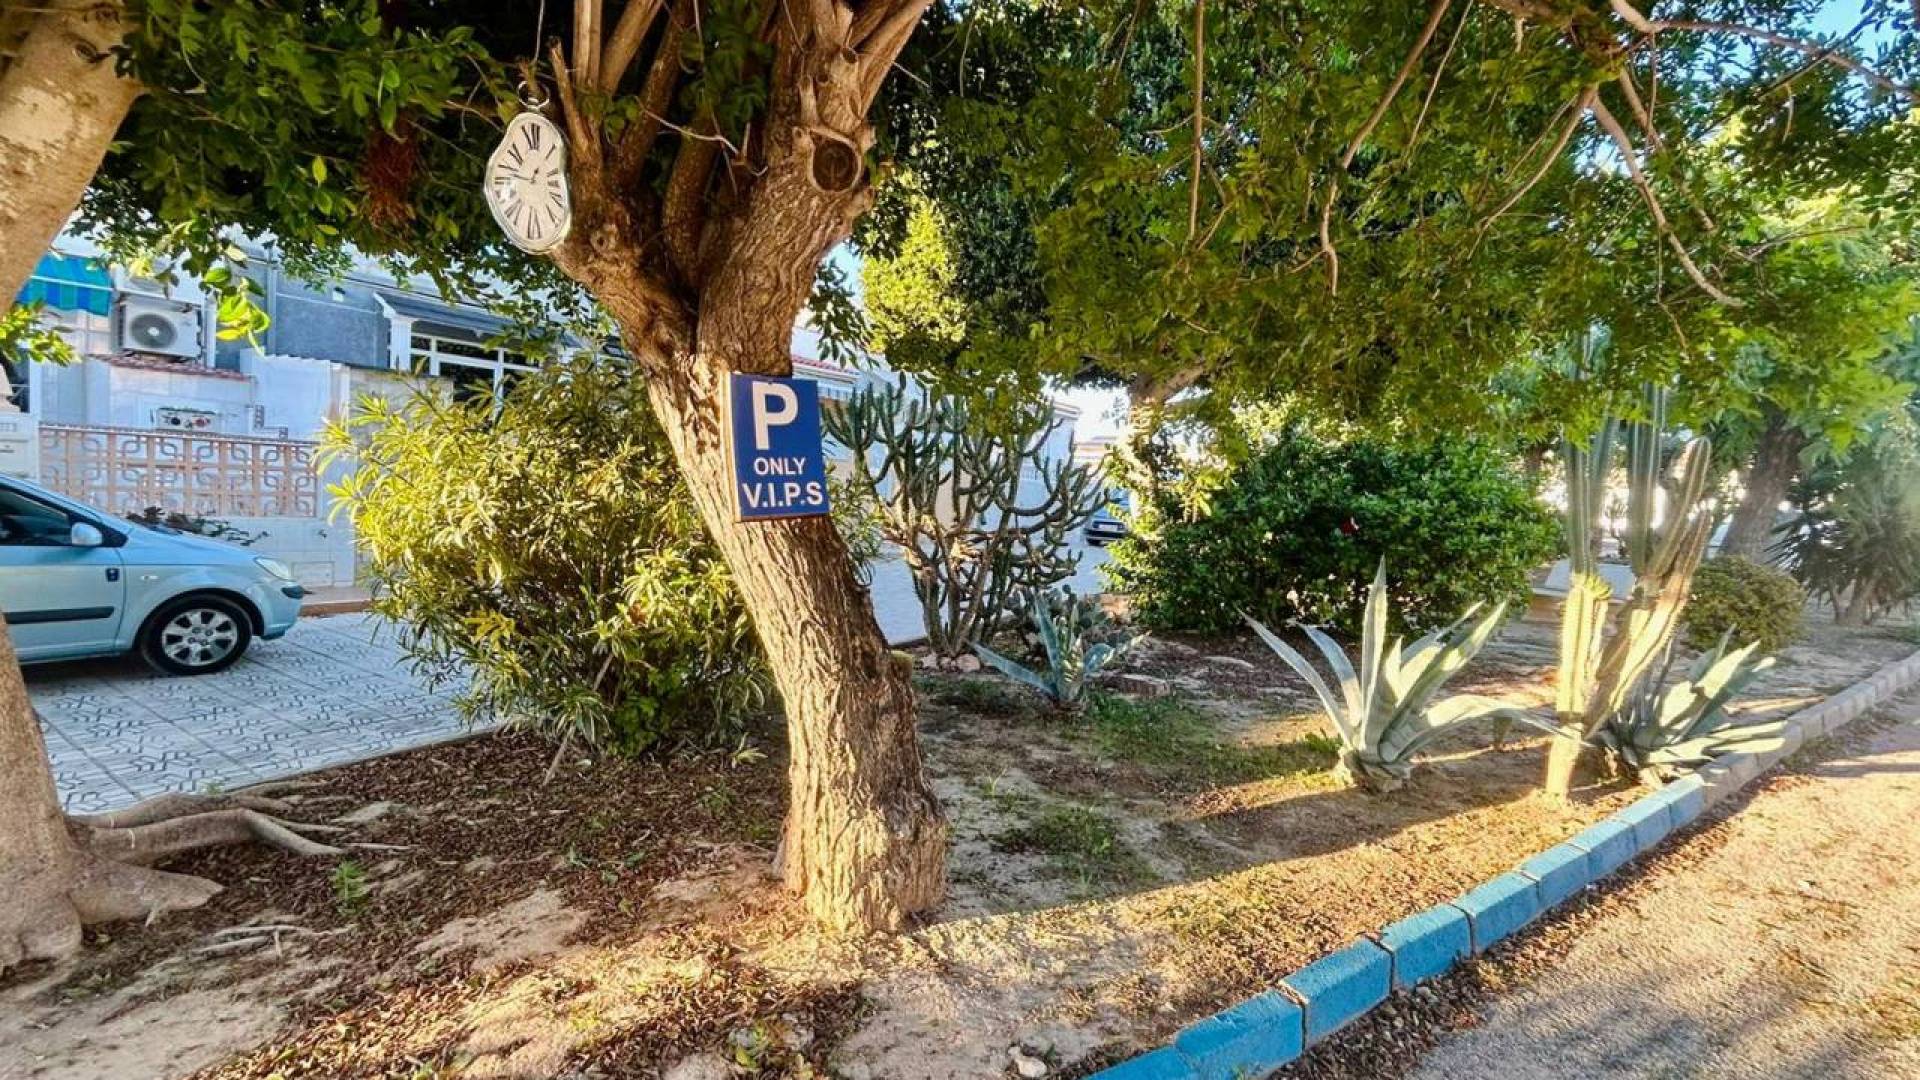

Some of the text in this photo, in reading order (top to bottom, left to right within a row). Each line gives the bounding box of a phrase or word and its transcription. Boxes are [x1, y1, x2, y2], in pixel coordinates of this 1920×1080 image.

[752, 381, 799, 450] P
[754, 457, 806, 476] ONLY
[742, 481, 824, 508] V.I.P.S
